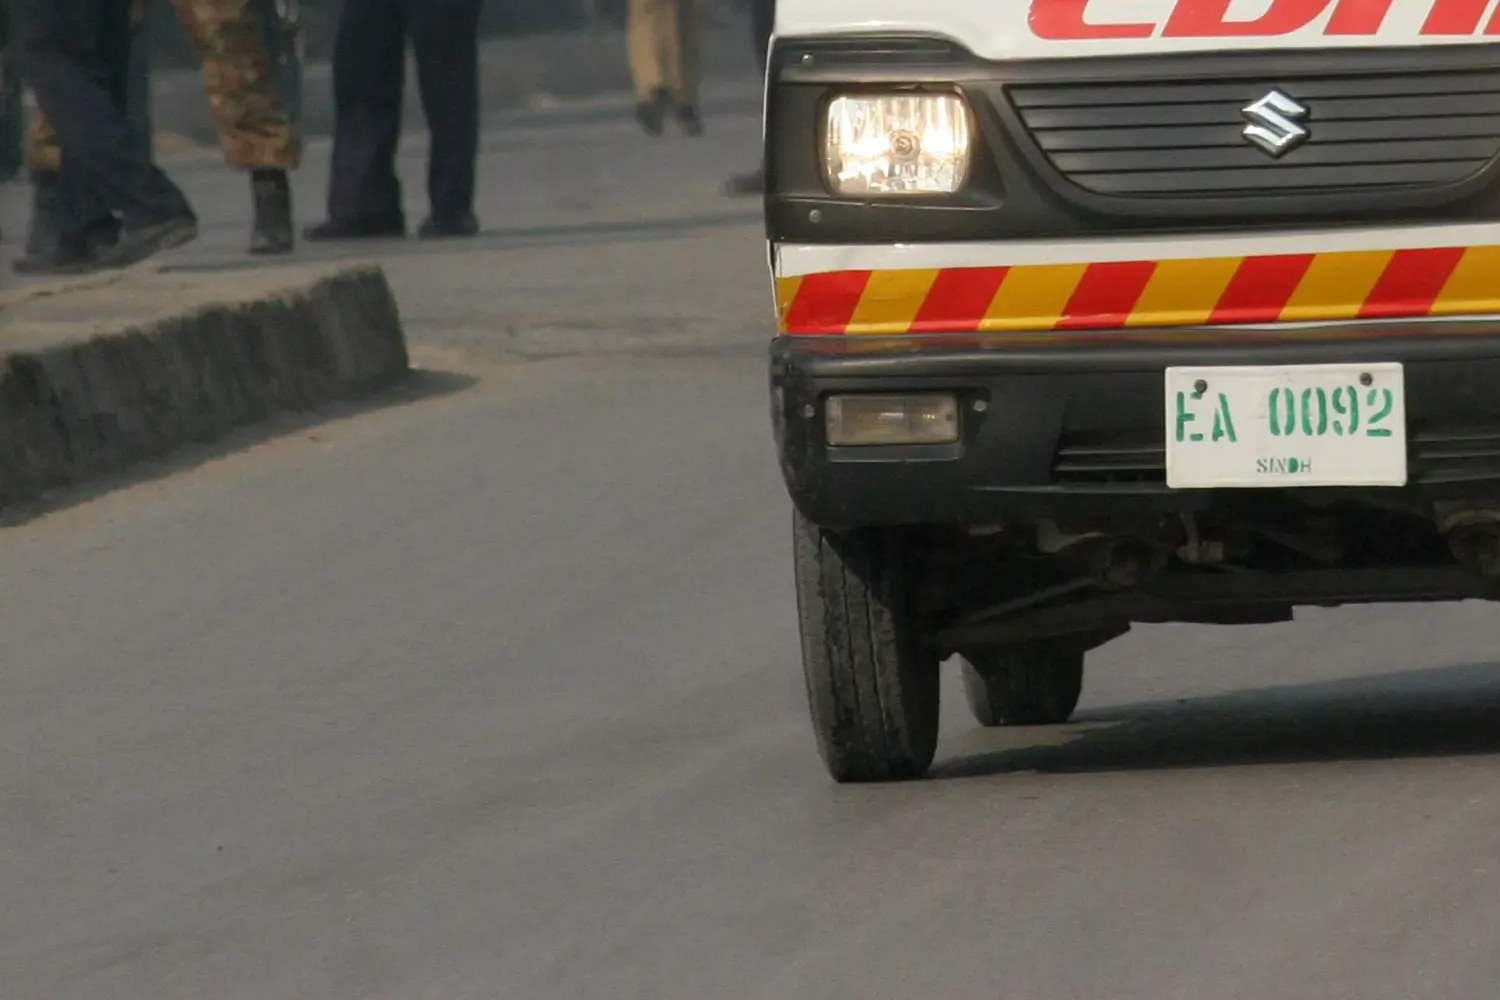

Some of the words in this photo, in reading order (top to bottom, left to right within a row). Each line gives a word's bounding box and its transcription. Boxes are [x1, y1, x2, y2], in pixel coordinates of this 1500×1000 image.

[1176, 391, 1237, 443] EA
[1268, 386, 1394, 438] 0092
[1256, 457, 1313, 474] SINDH
